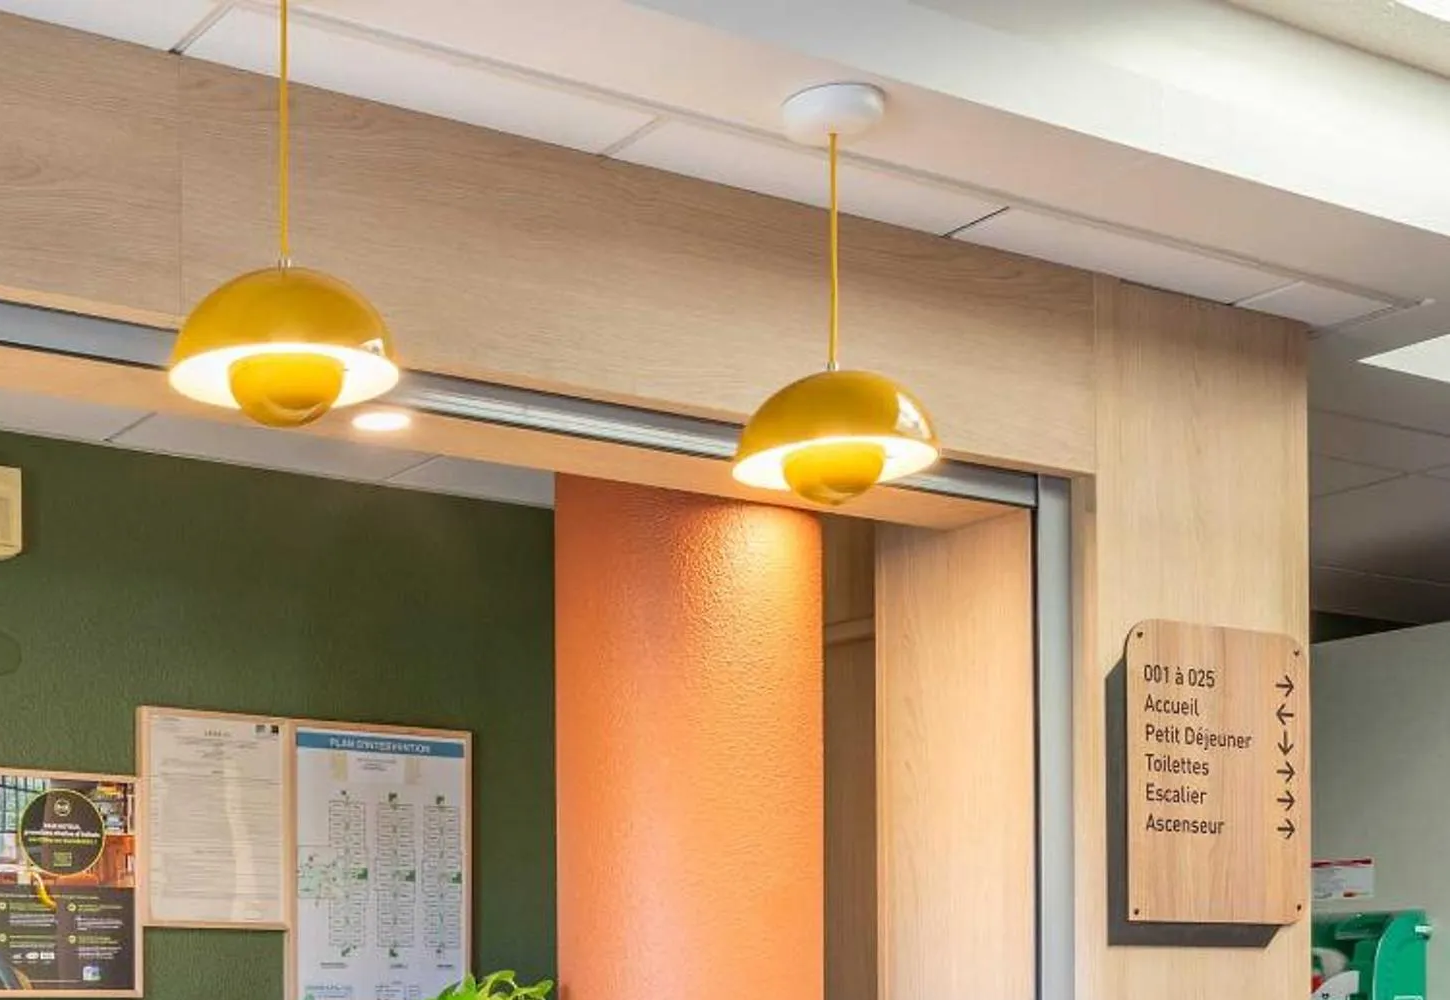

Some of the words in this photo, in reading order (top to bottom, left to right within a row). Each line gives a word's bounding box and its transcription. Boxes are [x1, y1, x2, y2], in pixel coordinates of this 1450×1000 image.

[1143, 664, 1170, 684] 001
[1175, 666, 1184, 685] à
[1188, 668, 1215, 688] 025
[1144, 695, 1200, 717] Accueil
[330, 737, 354, 749] PLAN
[1145, 726, 1181, 745] Petit
[1184, 728, 1252, 750] Déjeuner
[1145, 754, 1210, 776] Toilettes
[1146, 783, 1208, 805] Escalier
[1146, 813, 1226, 835] Ascenseur
